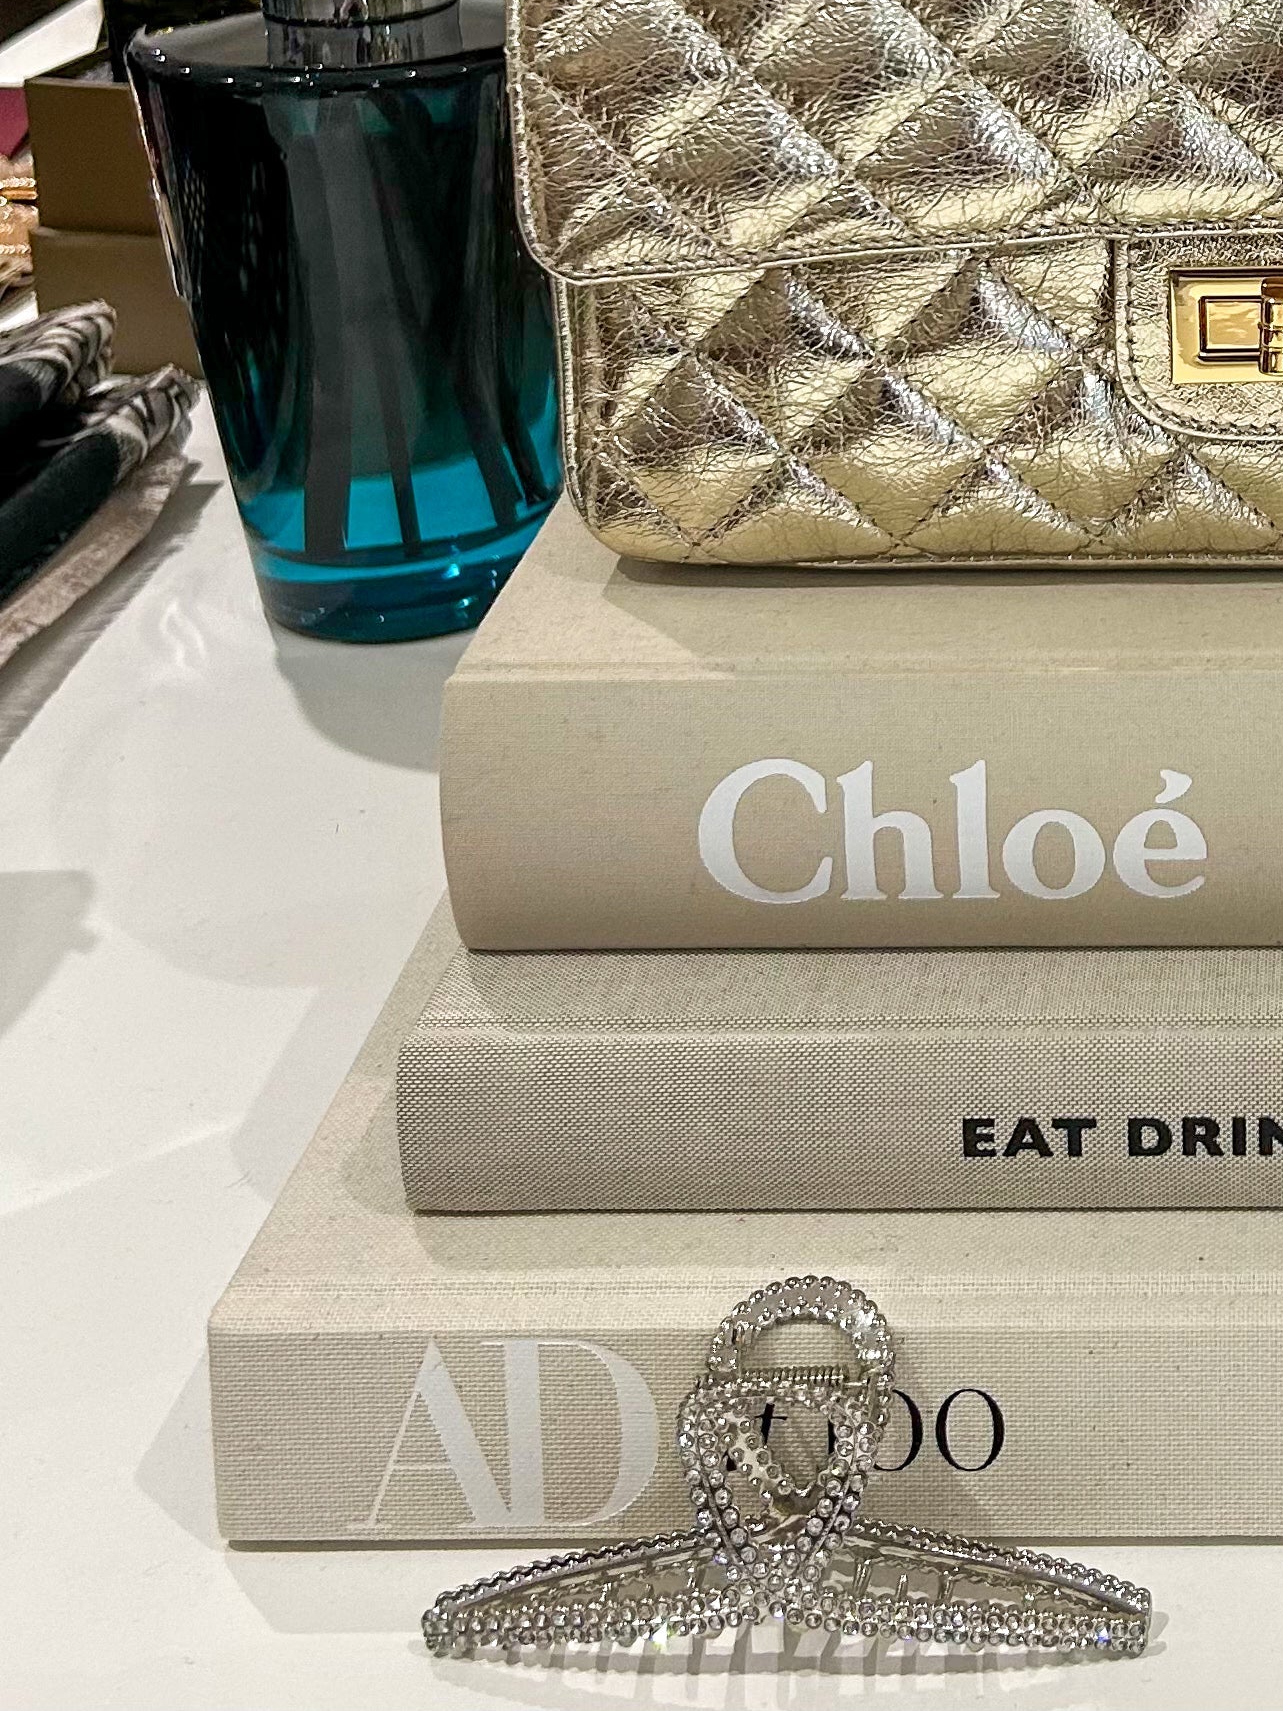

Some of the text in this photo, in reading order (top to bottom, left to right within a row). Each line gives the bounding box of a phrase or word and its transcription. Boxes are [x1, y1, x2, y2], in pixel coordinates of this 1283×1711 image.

[698, 757, 1208, 904] Chloé
[961, 1116, 1097, 1158] EAT
[358, 1336, 659, 1529] AD
